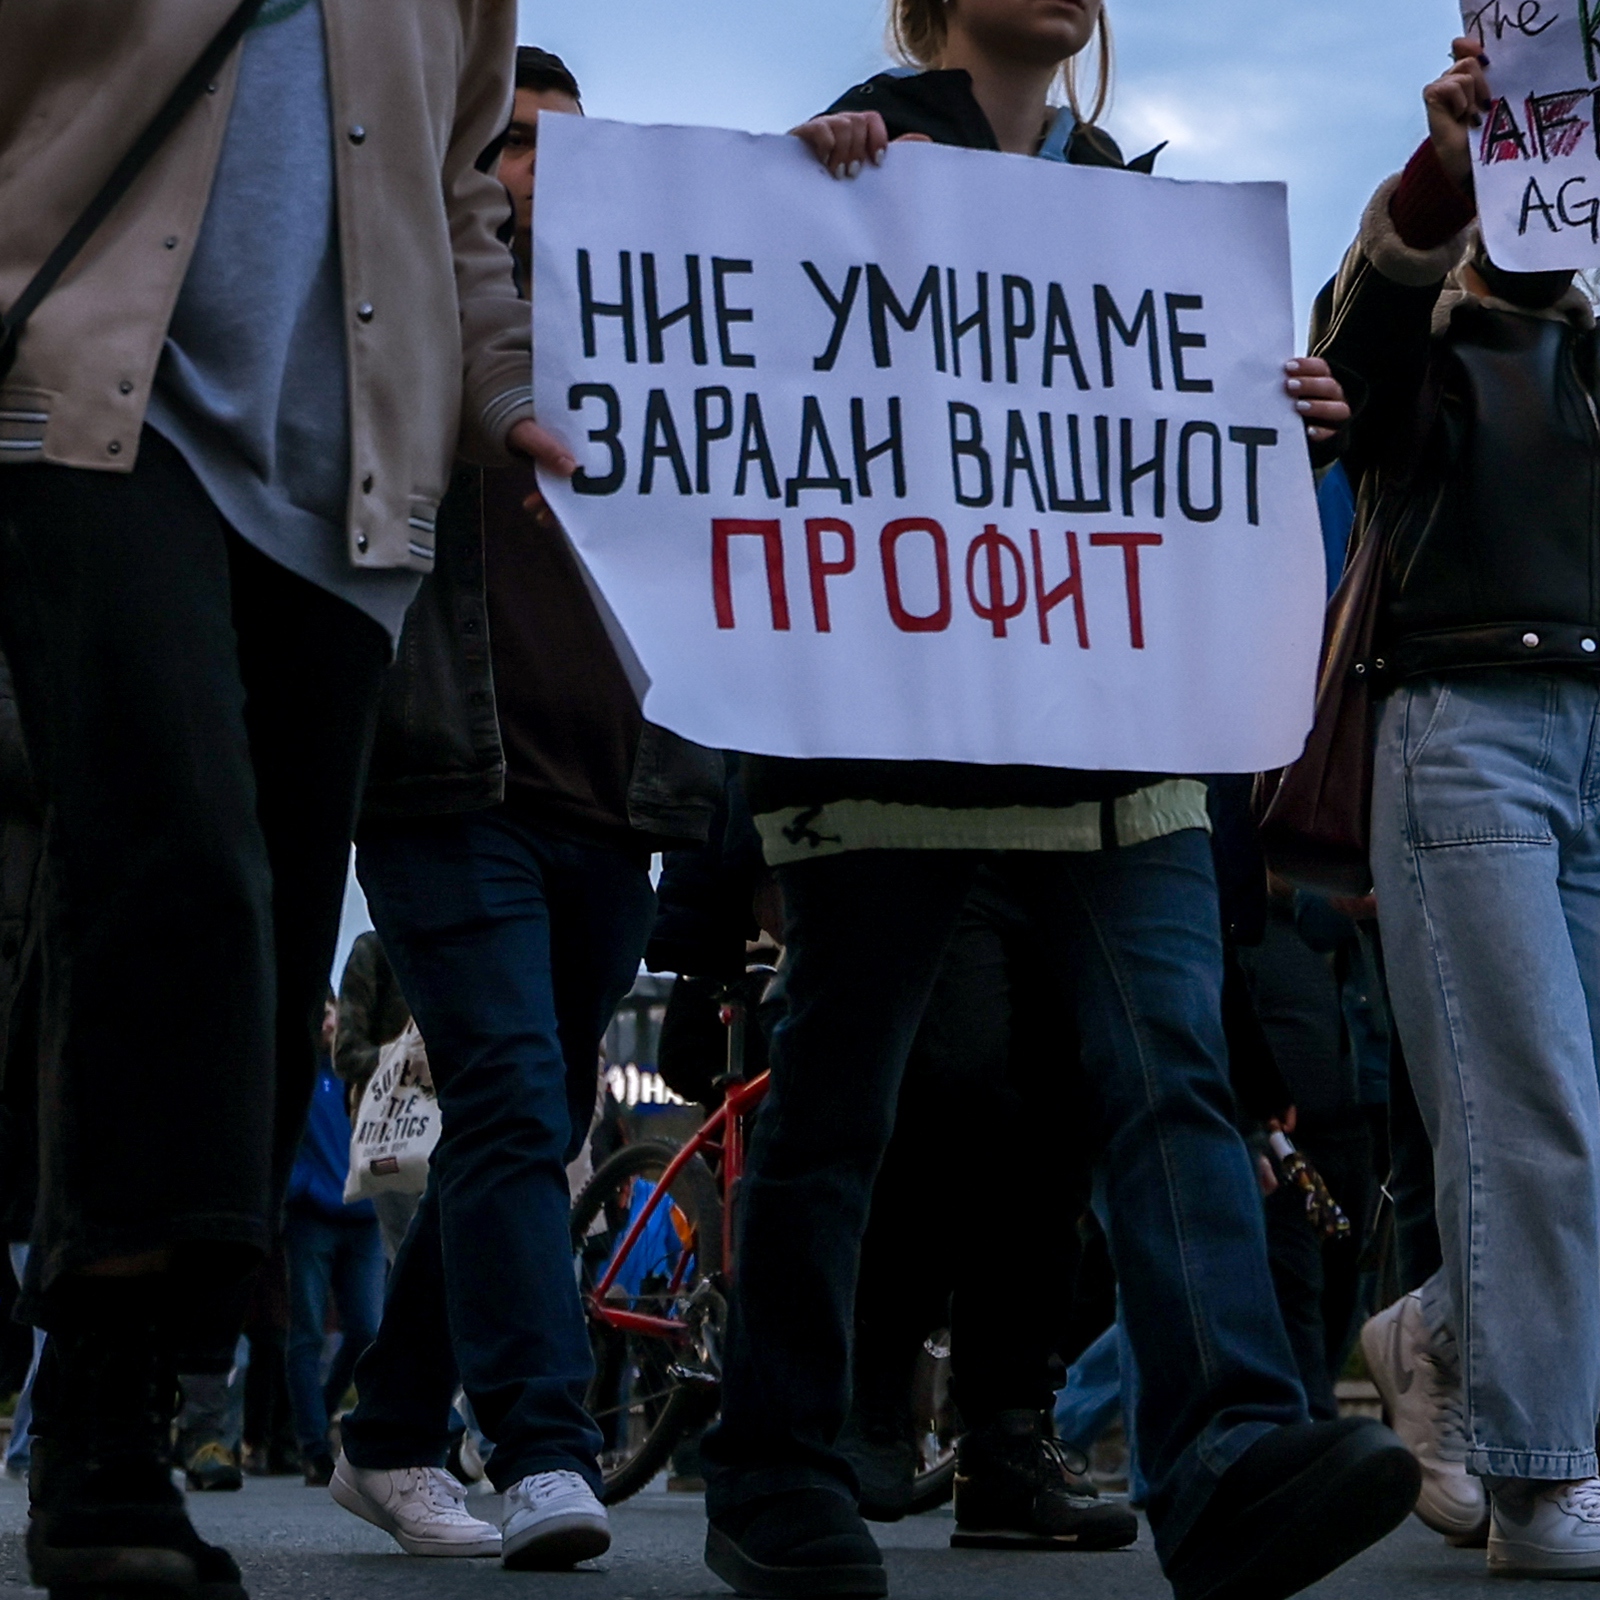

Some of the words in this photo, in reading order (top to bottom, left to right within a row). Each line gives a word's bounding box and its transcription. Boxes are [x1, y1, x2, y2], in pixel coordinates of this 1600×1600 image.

[576, 248, 758, 368] НИЕ
[799, 260, 1214, 394] УМИРАМЕ
[567, 382, 908, 510] ЗАРАДИ
[947, 399, 1280, 527] ВАШИОТ
[710, 516, 1164, 651] ПРОФИТ
